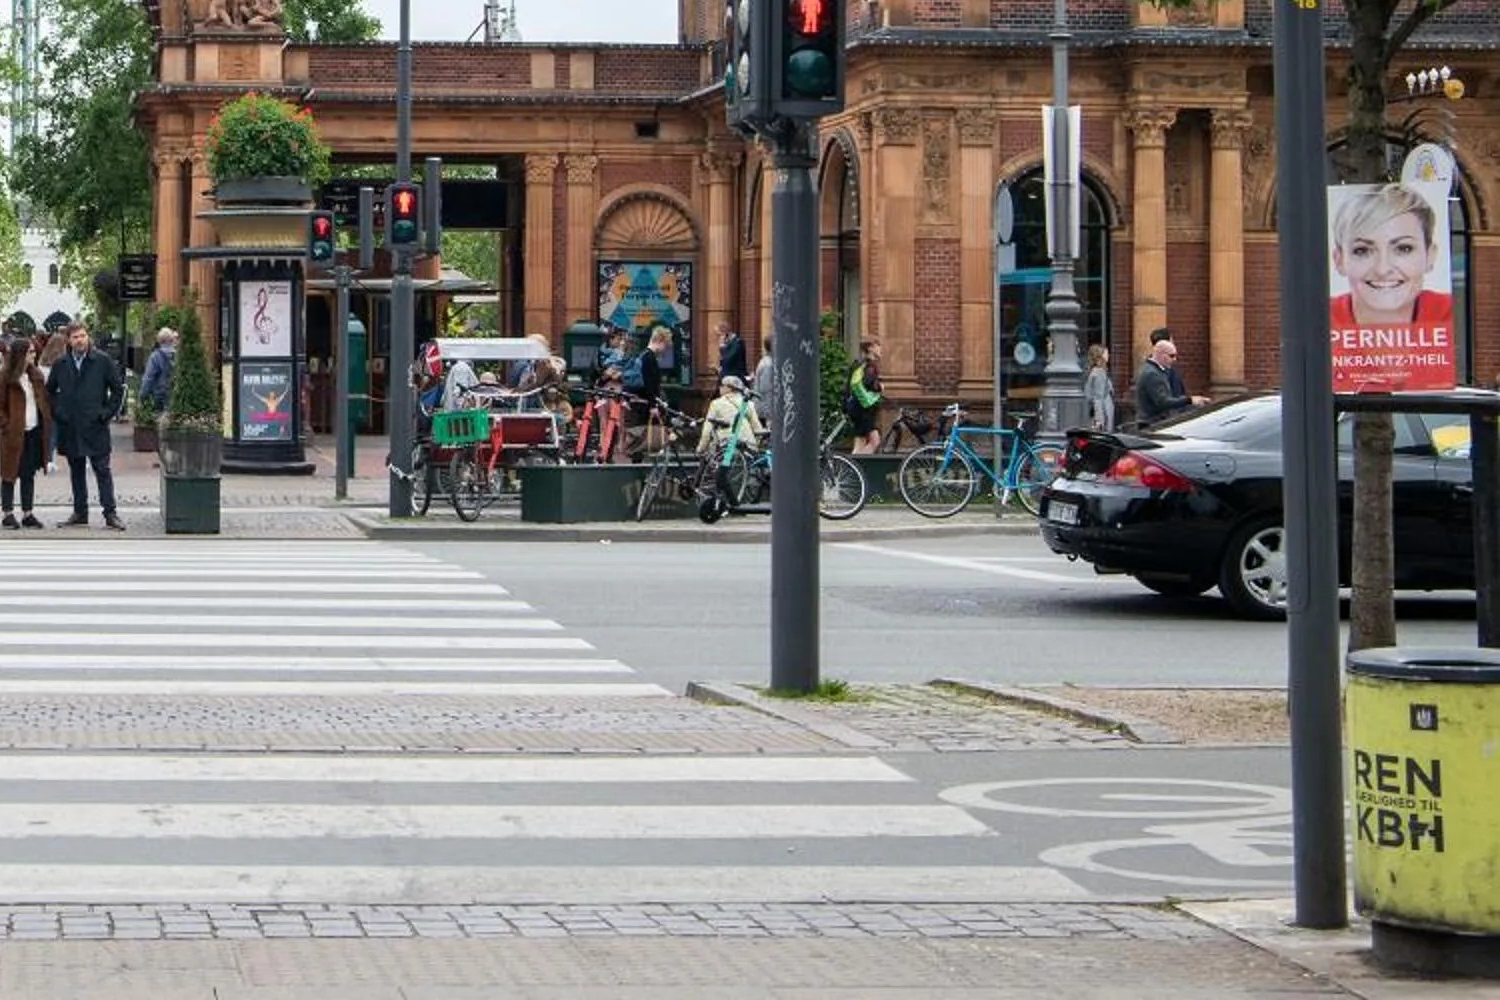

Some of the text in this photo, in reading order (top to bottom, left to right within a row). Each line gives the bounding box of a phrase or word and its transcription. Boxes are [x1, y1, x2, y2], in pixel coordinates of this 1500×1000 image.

[1330, 328, 1449, 348] PERNILLE
[1332, 353, 1450, 367] NKRANTZ-THEIL
[1354, 749, 1442, 797] REN
[1420, 799, 1443, 812] TIL
[1357, 803, 1445, 853] KBH
